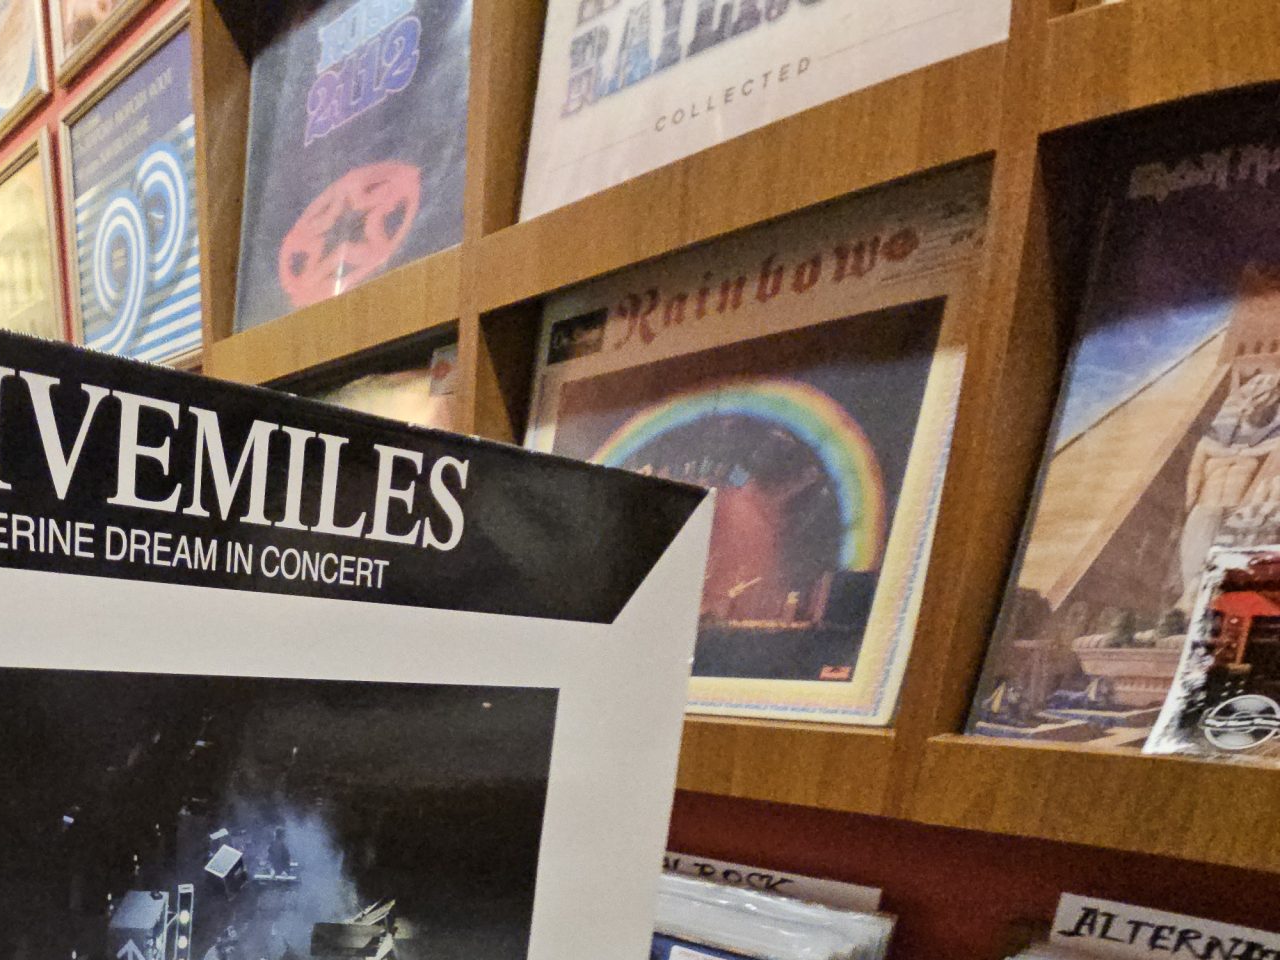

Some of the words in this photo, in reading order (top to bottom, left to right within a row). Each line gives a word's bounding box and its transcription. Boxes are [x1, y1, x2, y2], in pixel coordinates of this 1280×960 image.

[304, 16, 421, 147] 2112
[654, 56, 812, 132] COLLECTED
[613, 235, 881, 348] Rainbow
[105, 525, 219, 573] DREAM
[226, 540, 253, 575] IN
[260, 547, 389, 588] CONCERT
